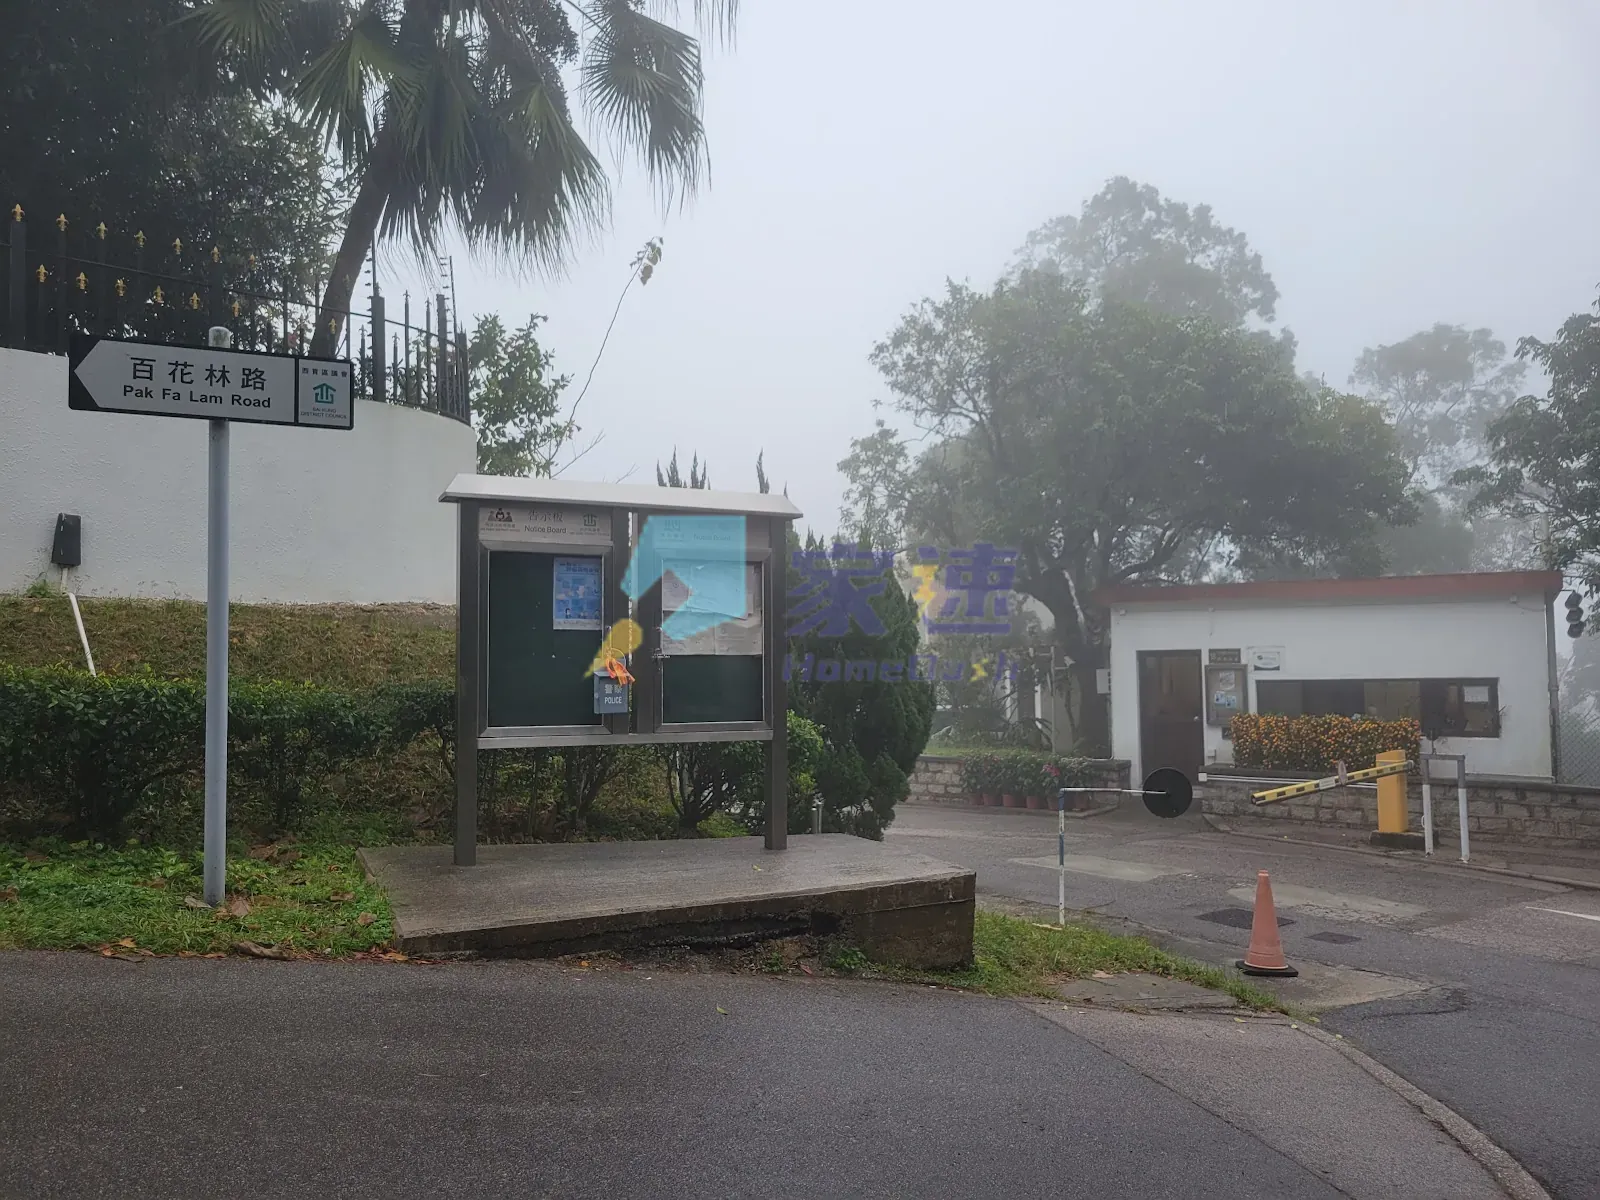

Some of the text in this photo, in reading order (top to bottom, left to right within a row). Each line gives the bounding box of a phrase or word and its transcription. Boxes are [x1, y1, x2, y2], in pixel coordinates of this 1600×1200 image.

[130, 356, 267, 391] 百花林路
[123, 384, 271, 409] Pak Fa Lam Road
[528, 509, 564, 522] 告示板
[524, 525, 546, 533] Notice
[546, 526, 567, 534] Board
[604, 696, 622, 704] POLICE
